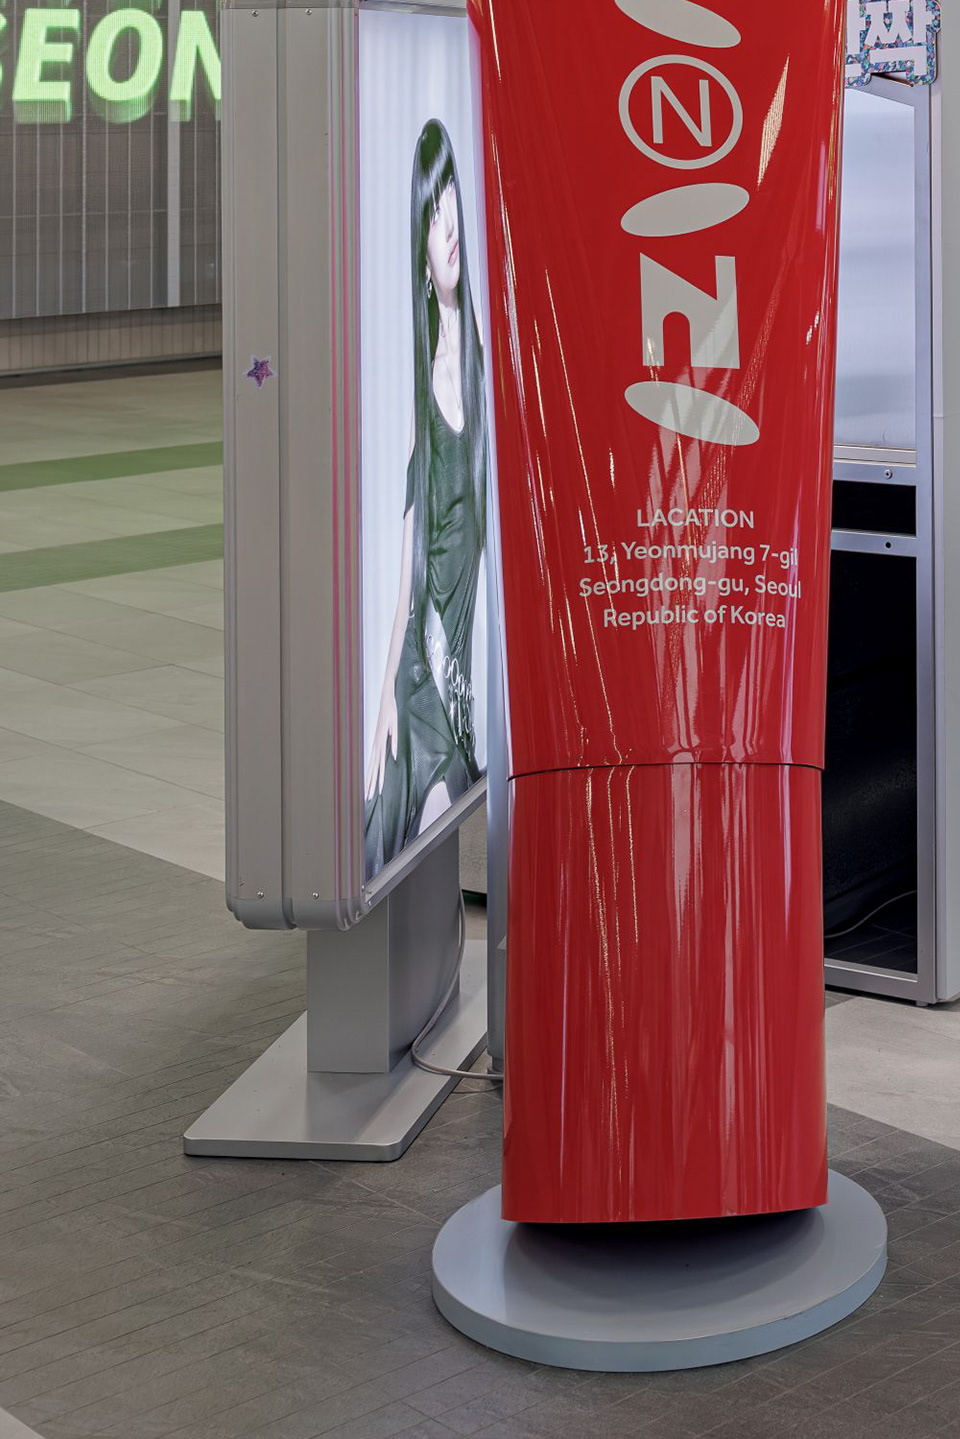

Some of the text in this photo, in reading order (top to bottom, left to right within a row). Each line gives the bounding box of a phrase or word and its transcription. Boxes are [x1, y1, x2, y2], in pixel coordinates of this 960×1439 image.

[0, 8, 221, 120] EON
[637, 508, 754, 528] LACATION
[621, 541, 755, 565] Yeonmujang
[759, 544, 798, 569] 7-gil
[579, 572, 801, 598] Seongdong-gu, Seoul
[604, 605, 786, 630] Republic of Korea
